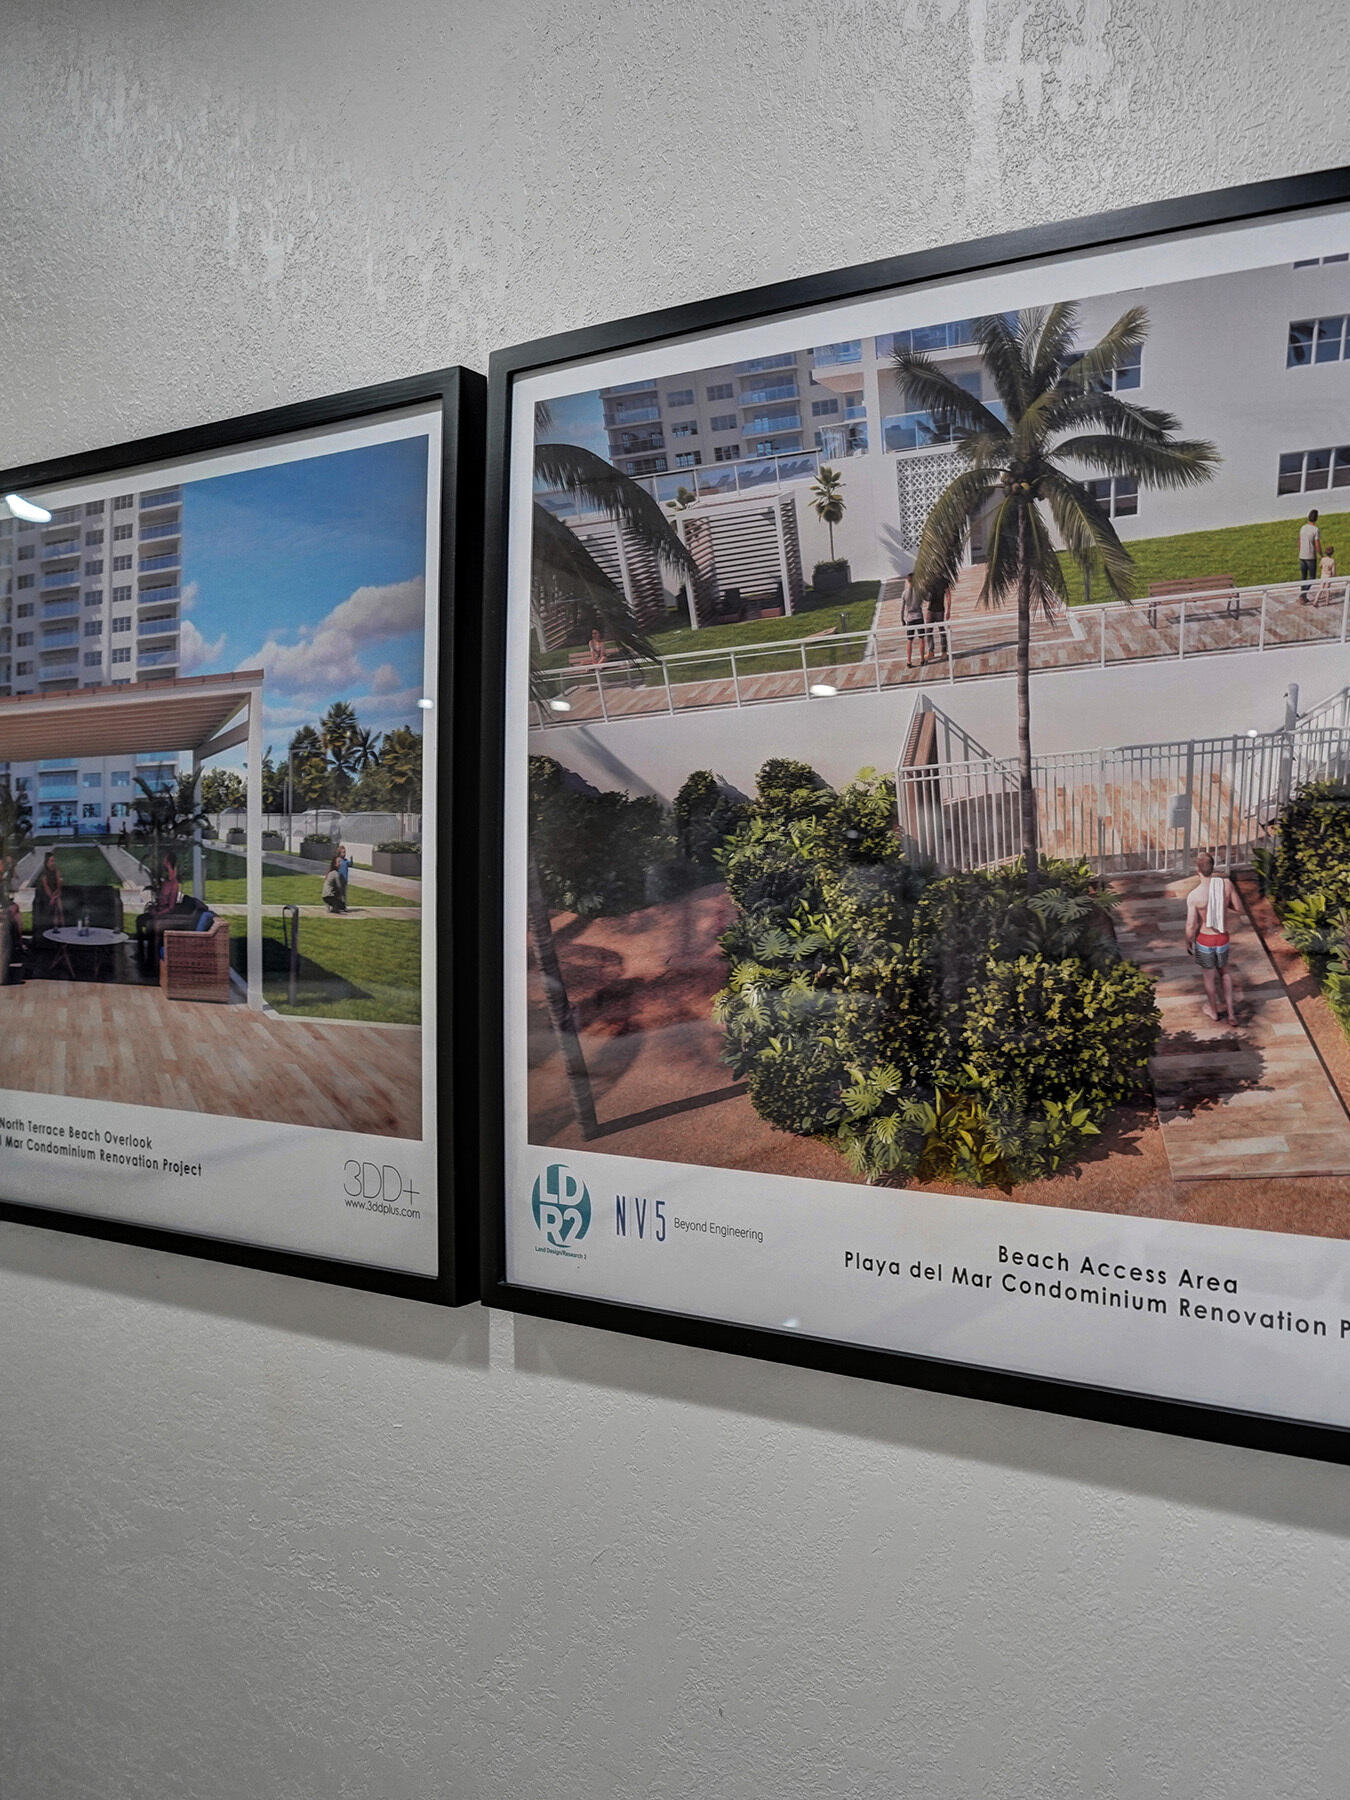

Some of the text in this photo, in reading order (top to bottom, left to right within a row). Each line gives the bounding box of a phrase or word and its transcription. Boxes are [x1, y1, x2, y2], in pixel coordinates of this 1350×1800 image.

[0, 1116, 152, 1150] North Terrace Beach Overlook
[5, 1135, 24, 1149] Mar
[26, 1138, 96, 1160] Condominium
[100, 1149, 159, 1170] Renovation
[163, 1158, 202, 1176] Project
[344, 1199, 421, 1219] www.3ddplus.com
[674, 1217, 708, 1234] Beyond
[709, 1222, 764, 1243] Engineering
[998, 1245, 1238, 1294] Beach Access Area
[845, 1251, 900, 1276] Playa
[910, 1261, 942, 1281] del
[952, 1266, 992, 1288] Mar
[1002, 1273, 1167, 1314] Condominium
[1179, 1297, 1327, 1336] Renovation
